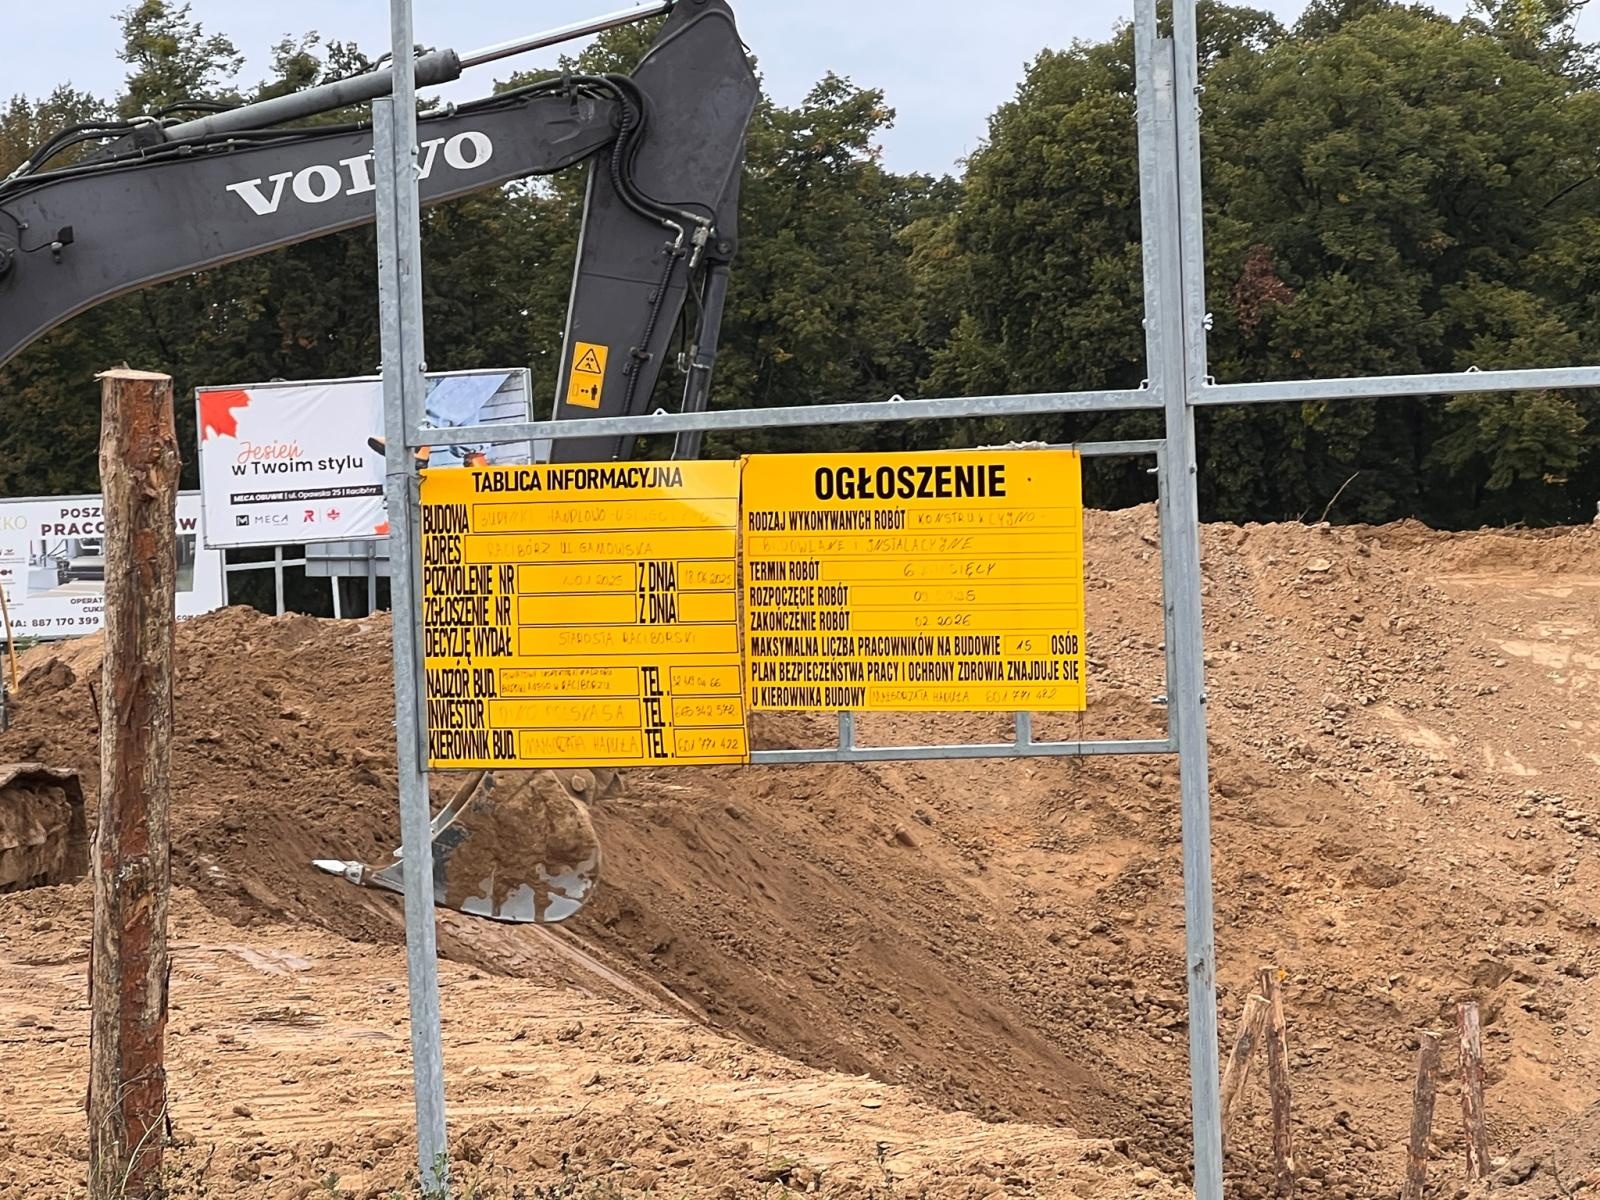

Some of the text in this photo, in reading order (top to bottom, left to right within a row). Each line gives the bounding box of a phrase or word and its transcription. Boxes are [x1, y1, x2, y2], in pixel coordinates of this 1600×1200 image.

[237, 440, 303, 464] Jesień
[232, 455, 364, 475] w Twoim stylu
[472, 468, 682, 492] TABLICA INFORMACYJNA
[815, 464, 1006, 501] OGŁOSZENIE
[61, 507, 104, 518] POSZ
[255, 514, 288, 524] MECA
[423, 504, 469, 534] BUDOWA
[749, 511, 785, 531] RODZAJ
[789, 510, 871, 531] WYKONYWANYCH
[875, 506, 905, 530] ROBÓT
[424, 535, 461, 565] ADRES
[763, 538, 845, 552] BDOWLANE
[424, 565, 515, 595] POZWOLENIE NR
[639, 561, 676, 592] Z DNIA
[750, 558, 820, 581] TERMIN ROBÓT
[903, 563, 915, 577] 6
[640, 593, 676, 623] Z DNIA
[750, 582, 848, 609] ROZPOCZĘCIE ROBÓT
[32, 619, 51, 627] 887
[56, 618, 74, 626] 170
[79, 617, 99, 625] 399
[425, 596, 511, 626] ZGŁOSZENIE NR
[751, 607, 850, 631] ZAKOŃCZENIE ROBÓT
[425, 627, 512, 665] DECYZJĘ WYDAŁ
[752, 632, 1000, 657] MAKSYMALNA LICZBA PRACOWNIKÓW NA BUDOWIE
[1016, 640, 1032, 651] 15
[1051, 631, 1078, 655] OSÓB
[426, 659, 497, 698] NADZÓR BUD.
[752, 658, 1079, 684] PLAN BEZPIECZEŃSTWA PRACY I OCHRONY ZDROWIA ZNAJDUJE SIĘ
[752, 687, 866, 706] U KIEROWNIKA BUDOWY
[428, 699, 484, 729] INWESTOR
[429, 730, 516, 759] KIEROWNIK BUD.
